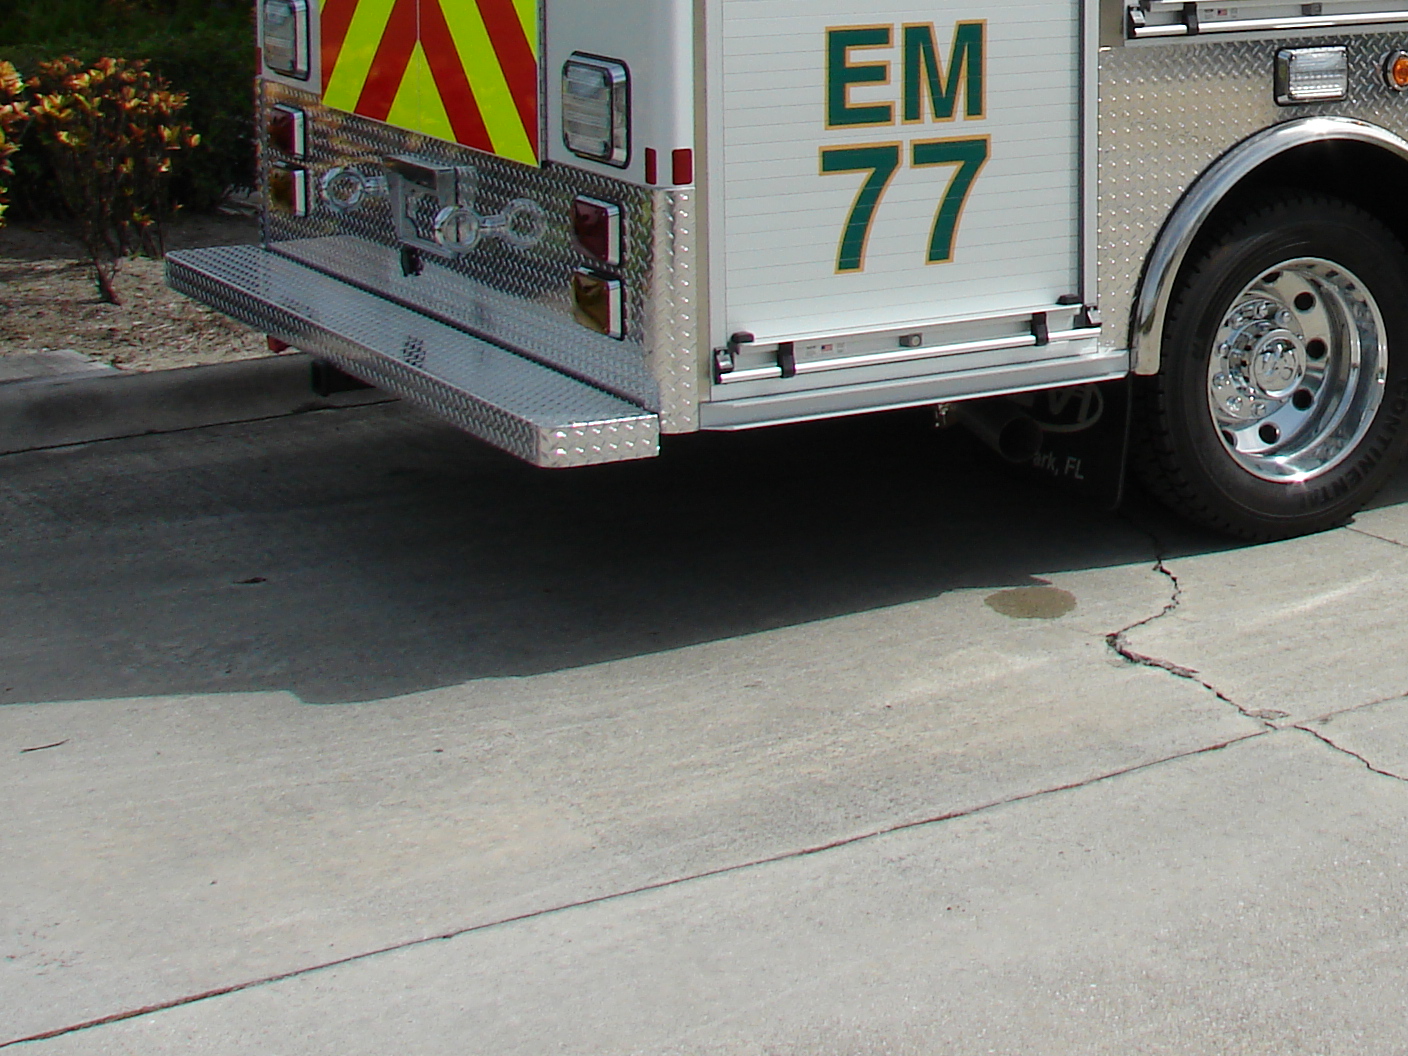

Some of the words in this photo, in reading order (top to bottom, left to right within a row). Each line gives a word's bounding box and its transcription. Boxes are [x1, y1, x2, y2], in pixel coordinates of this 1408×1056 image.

[824, 18, 988, 131] EM
[818, 133, 992, 275] 77
[1064, 455, 1085, 480] FL
